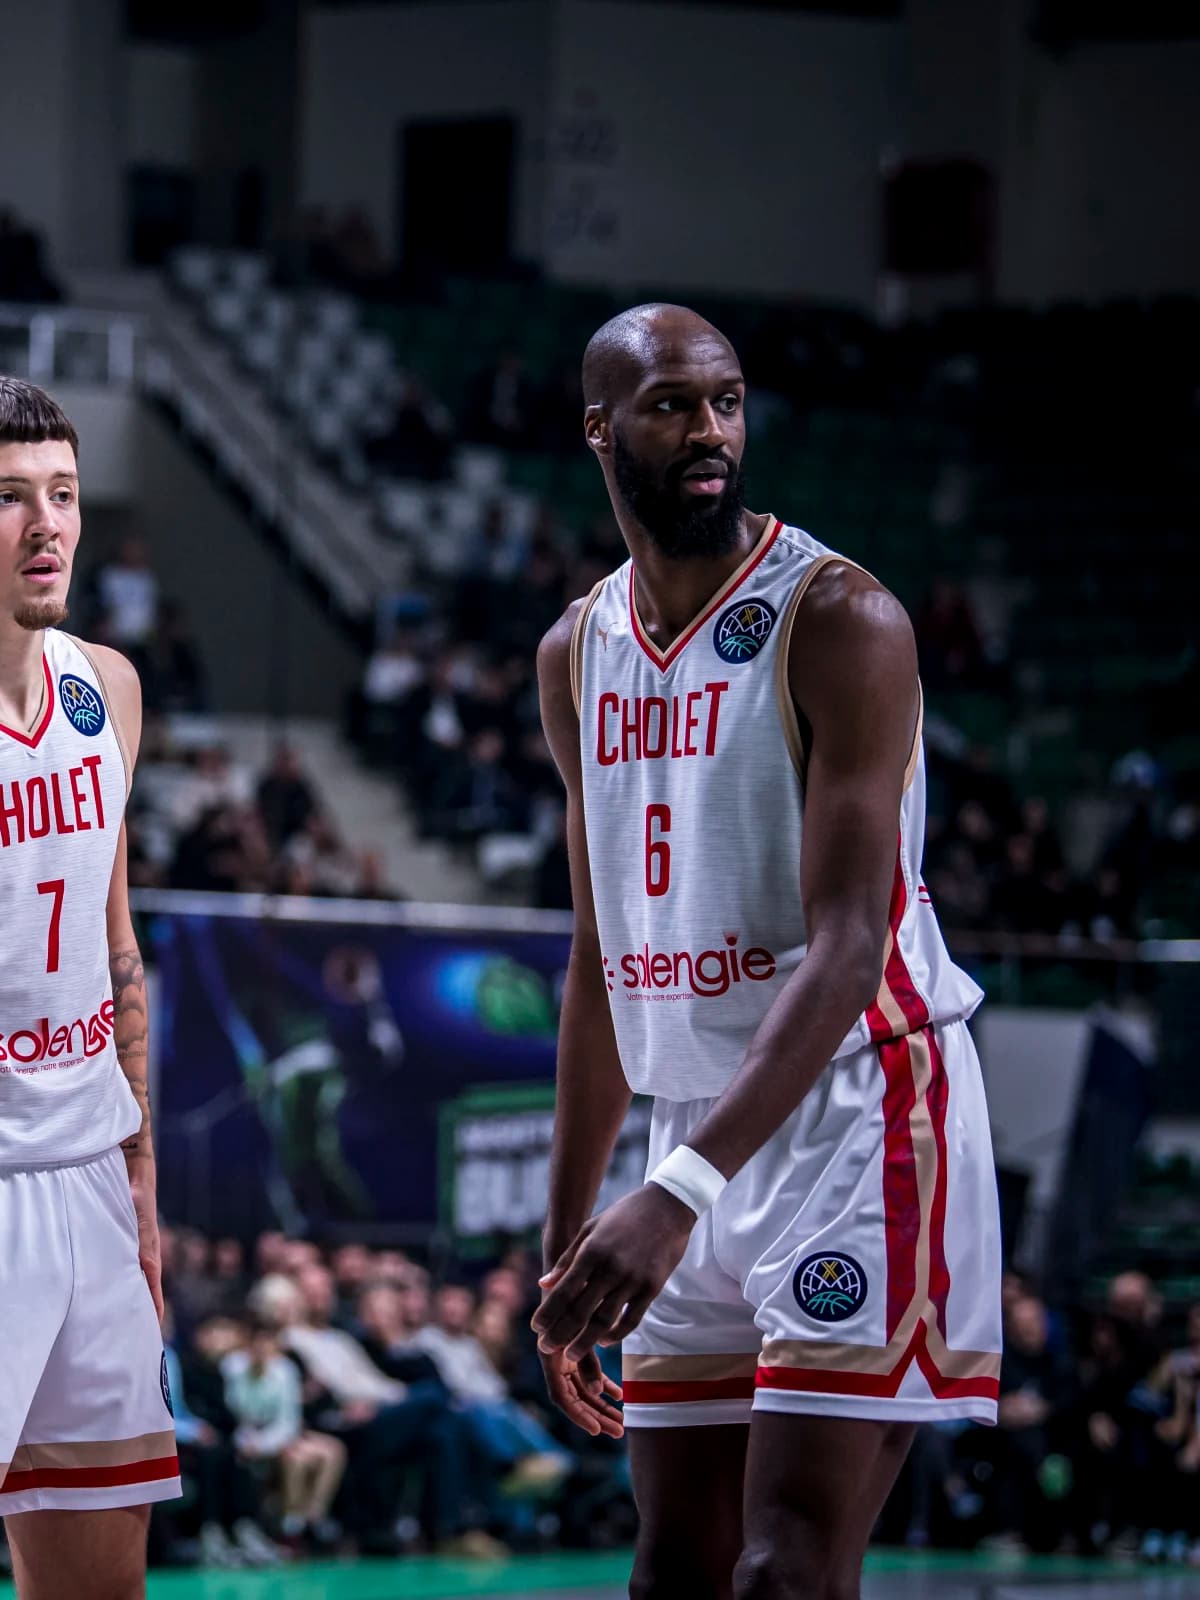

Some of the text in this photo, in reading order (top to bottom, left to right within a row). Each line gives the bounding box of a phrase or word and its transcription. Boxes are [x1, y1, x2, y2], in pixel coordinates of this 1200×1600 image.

[597, 681, 729, 766] CHOLET
[645, 803, 671, 897] 6
[37, 879, 65, 973] 7
